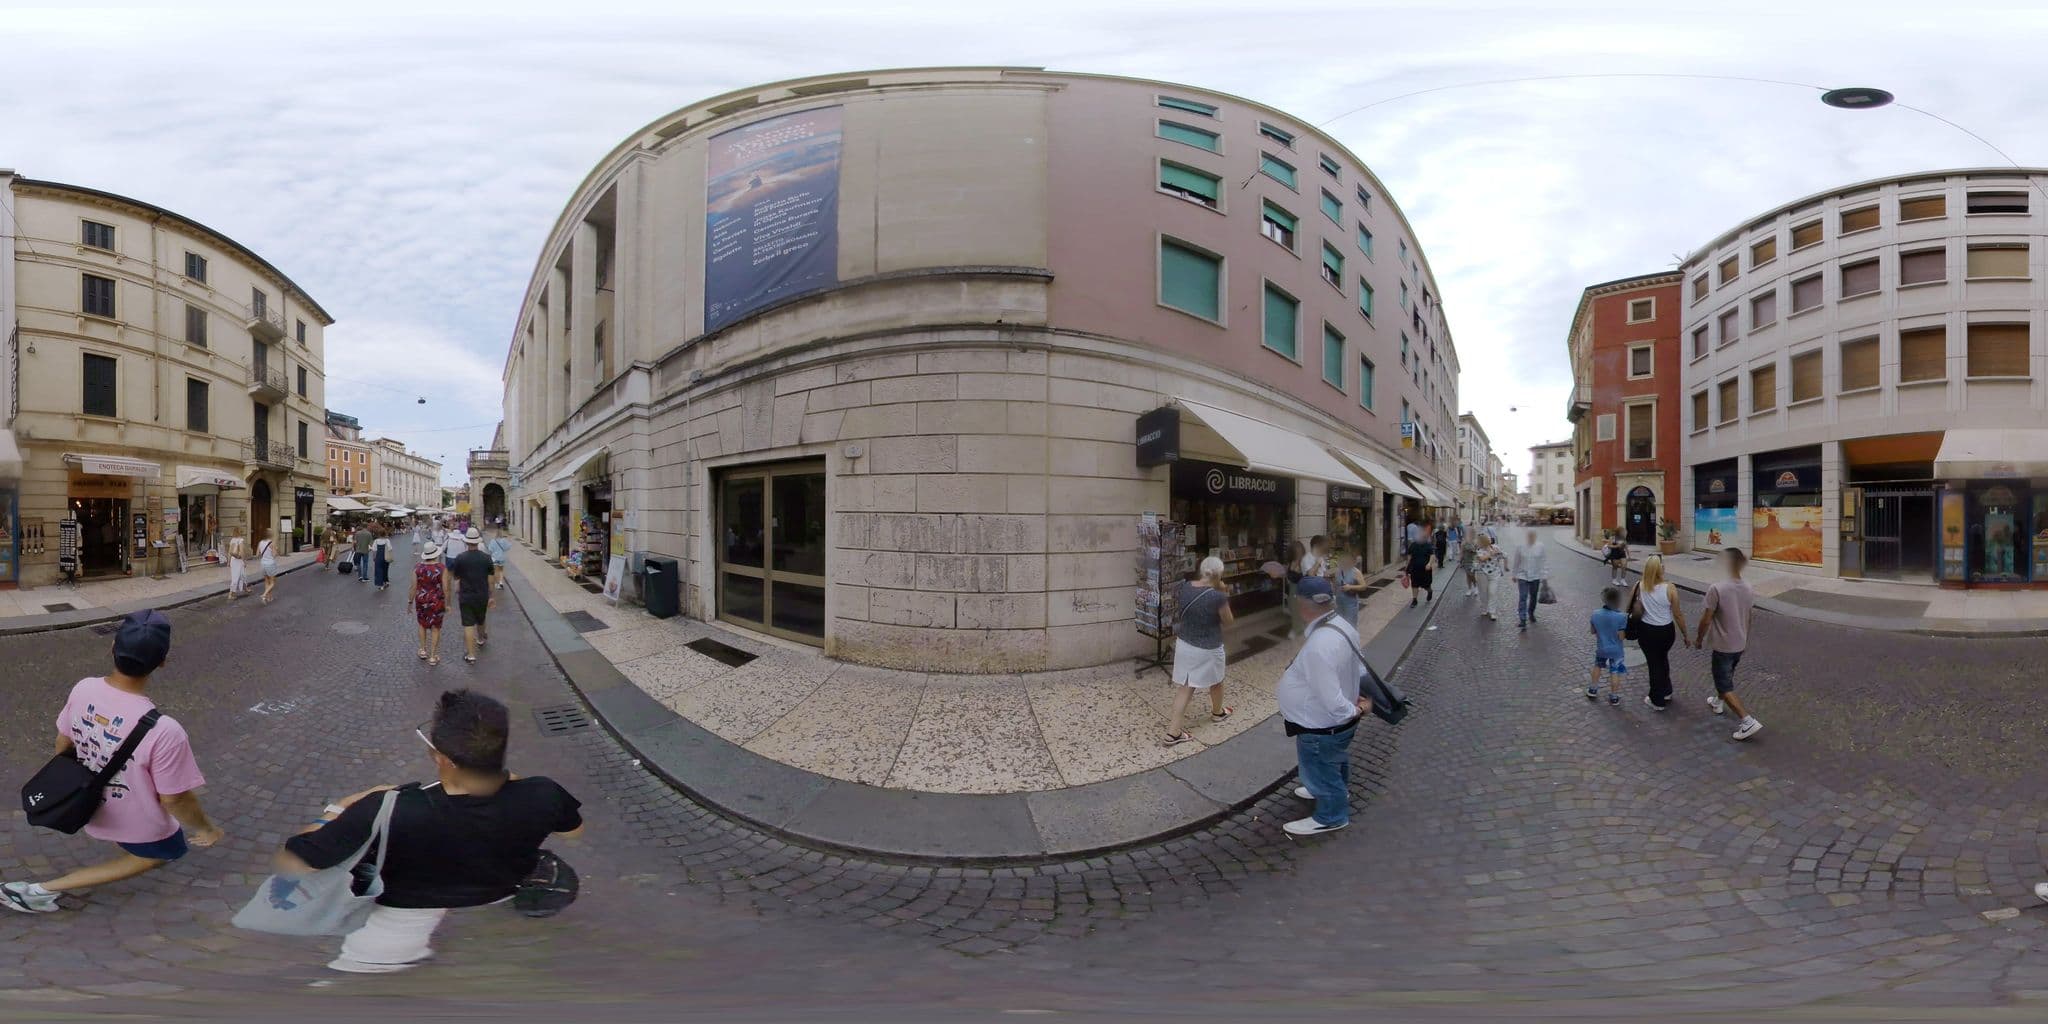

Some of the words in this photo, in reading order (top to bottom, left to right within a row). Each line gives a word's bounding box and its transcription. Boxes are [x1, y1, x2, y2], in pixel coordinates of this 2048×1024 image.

[1137, 430, 1161, 446] LIBRACCIO
[98, 463, 125, 471] ENOTECA
[1229, 475, 1276, 493] LIBRACCIO
